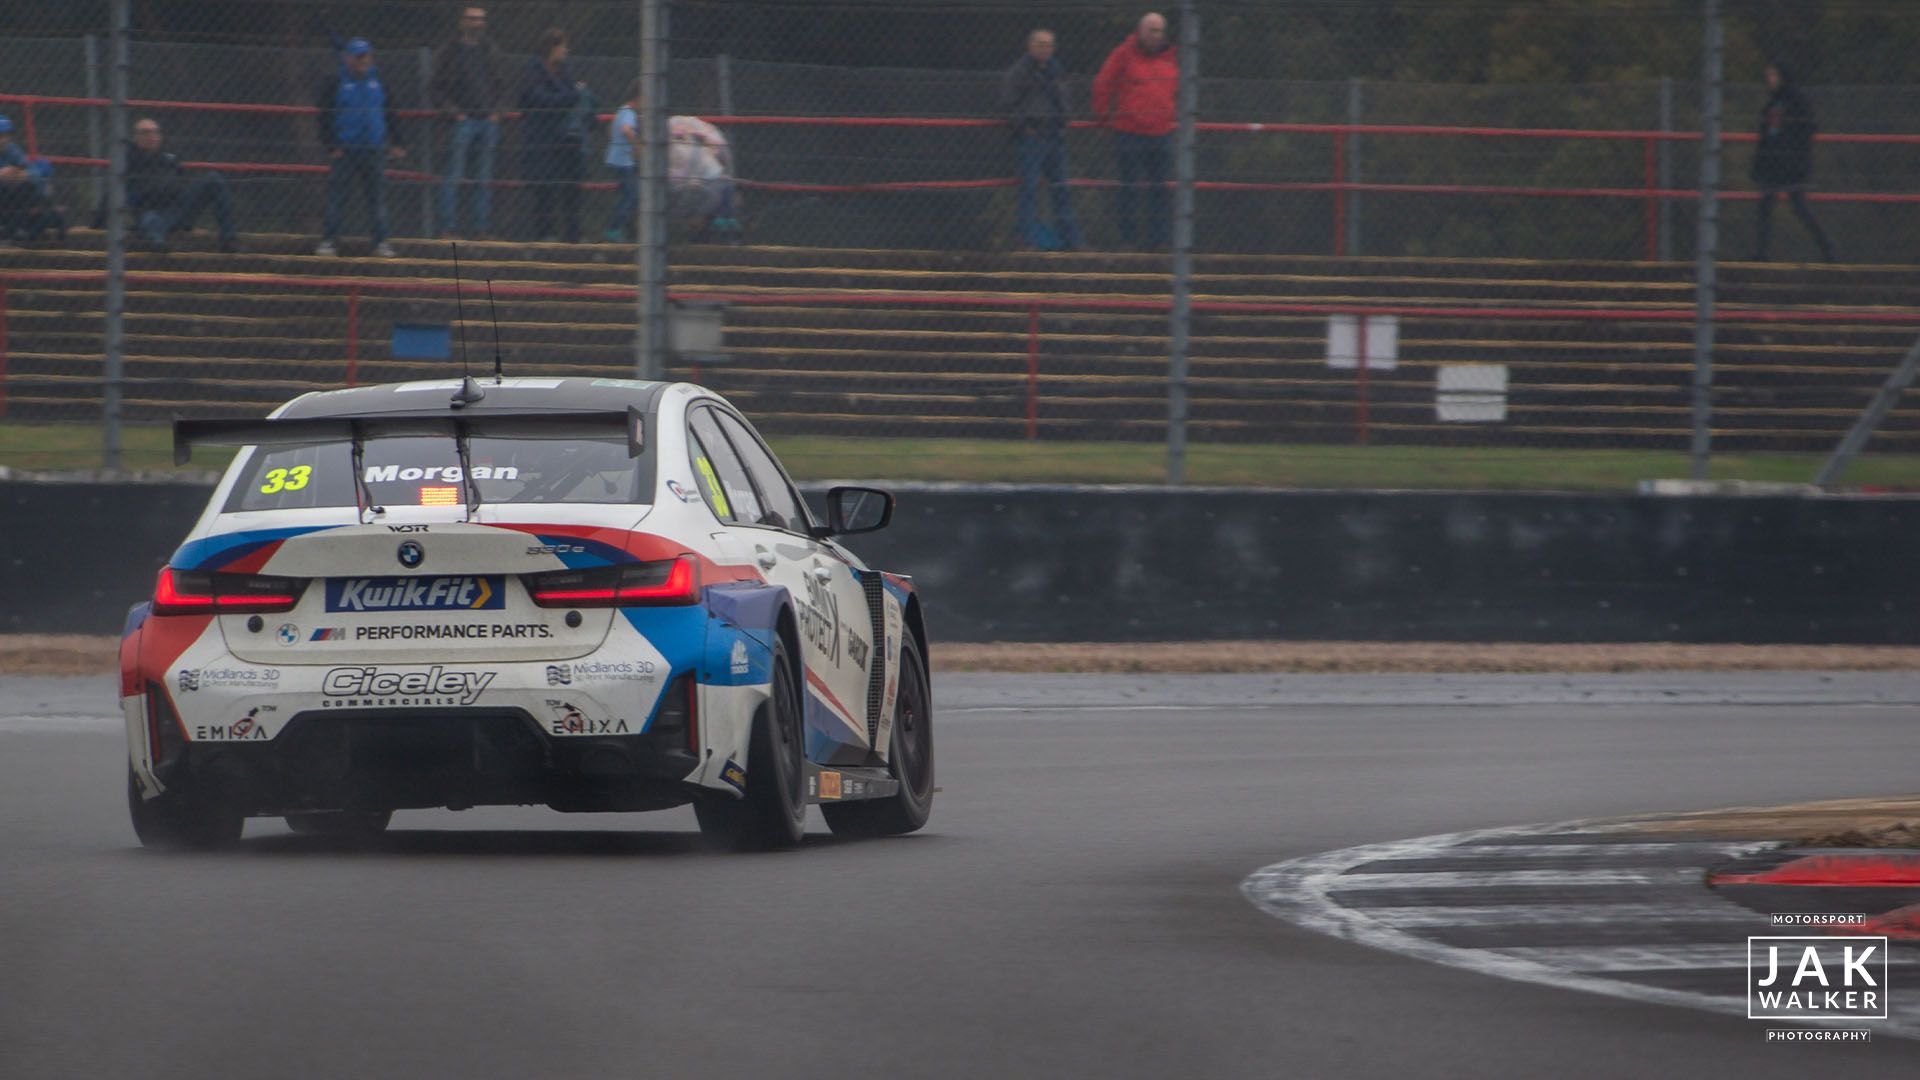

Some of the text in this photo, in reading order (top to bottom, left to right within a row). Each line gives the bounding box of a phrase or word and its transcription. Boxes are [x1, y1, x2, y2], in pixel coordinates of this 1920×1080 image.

[260, 465, 312, 494] 33
[364, 464, 519, 483] Morgan
[356, 625, 488, 640] PERFORMANCE
[491, 624, 554, 639] PARTS.
[202, 668, 281, 680] Midlands 3D
[573, 661, 655, 674] Midlands 3D
[322, 666, 497, 705] Ciceley
[322, 697, 455, 708] COMMERCIALS
